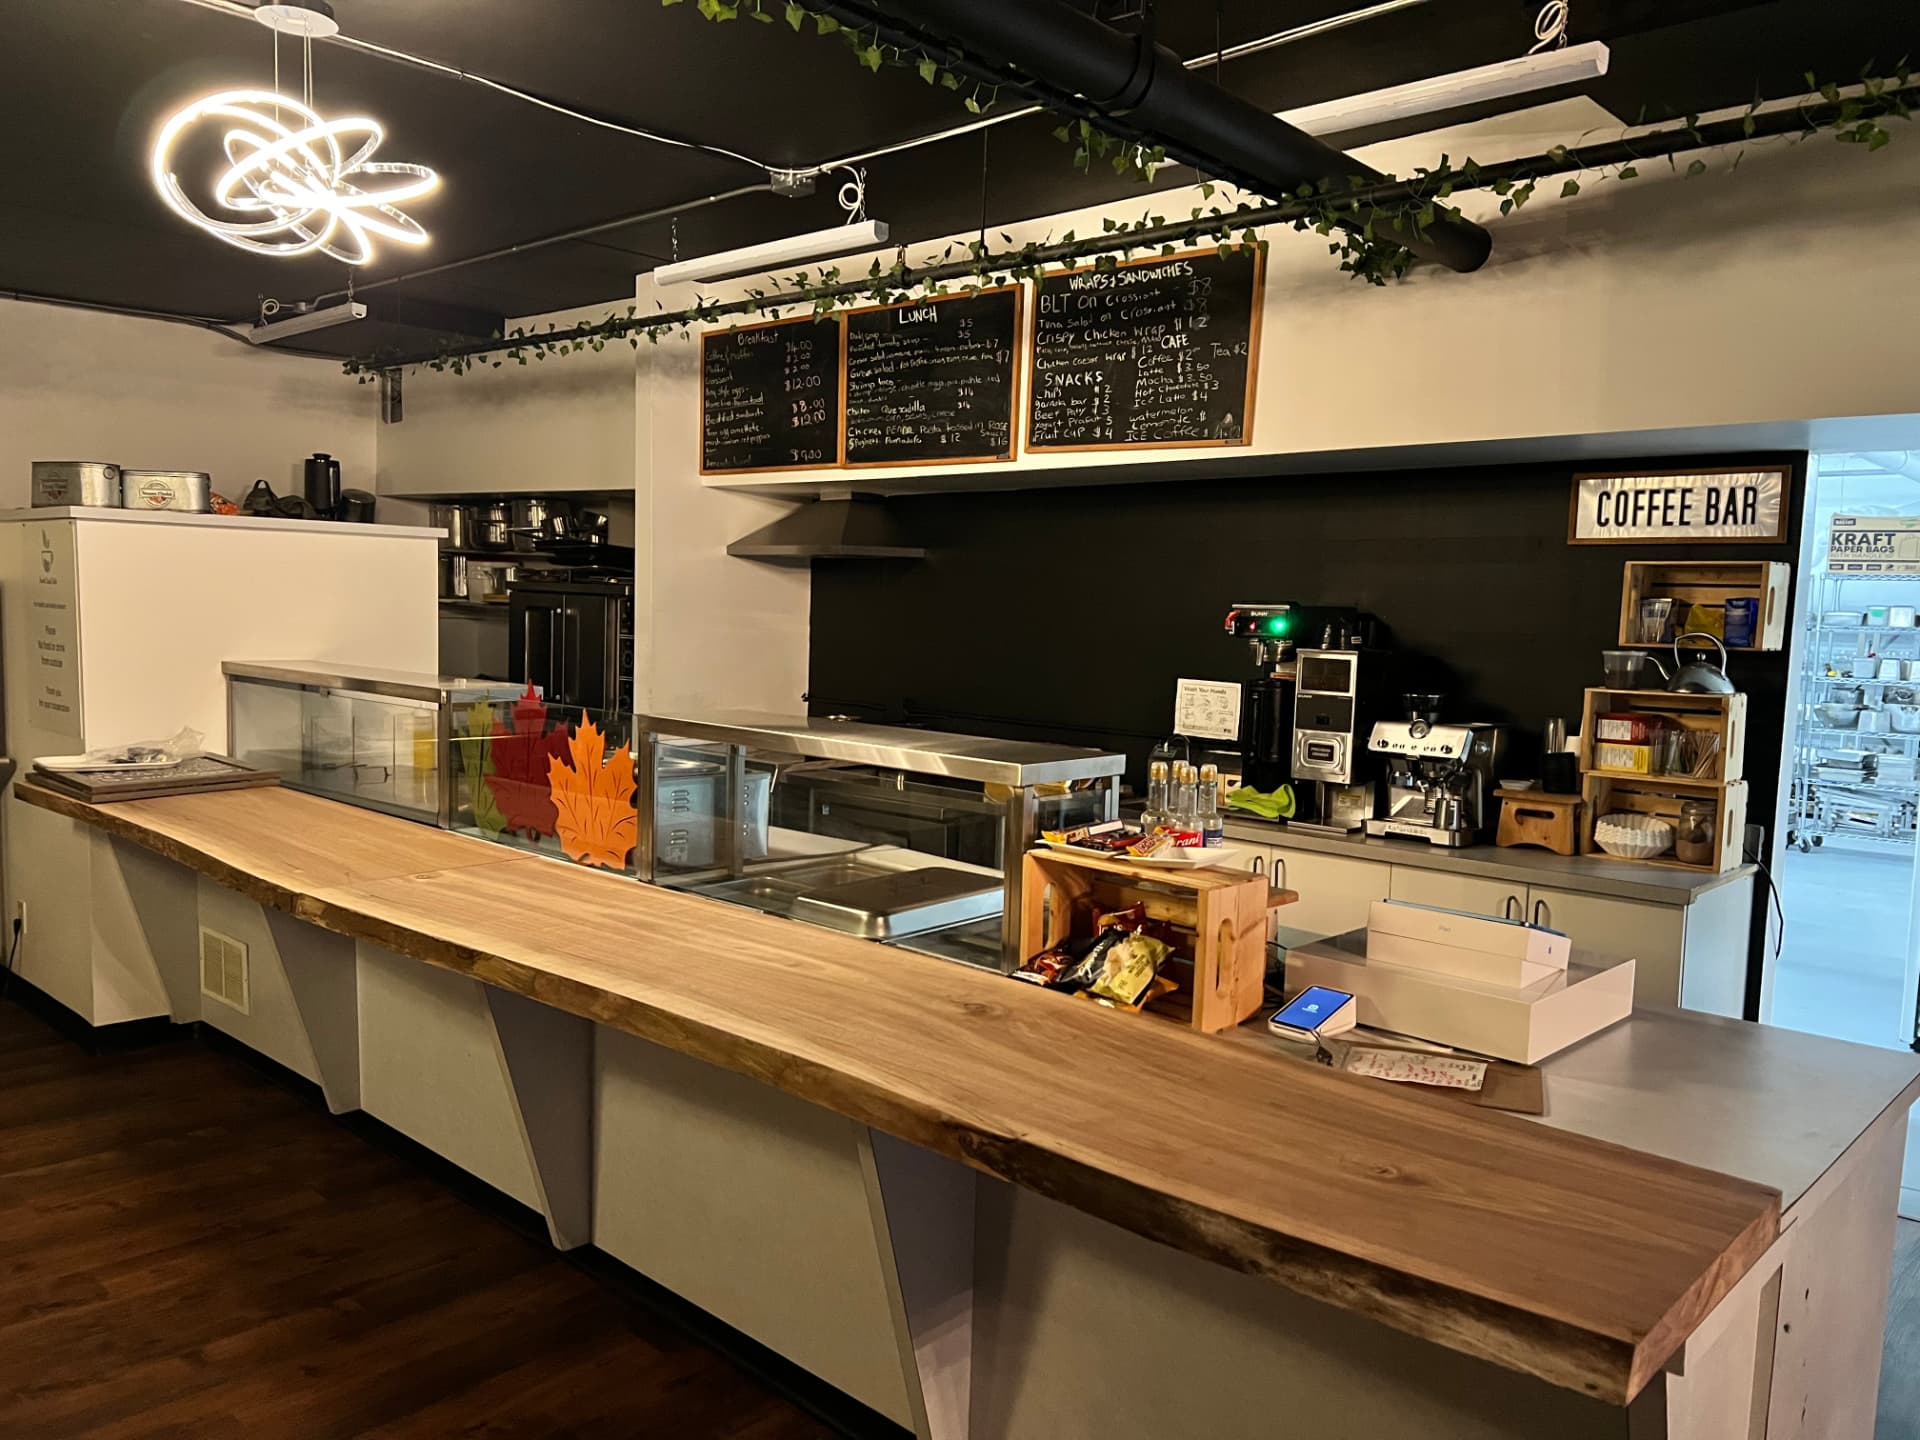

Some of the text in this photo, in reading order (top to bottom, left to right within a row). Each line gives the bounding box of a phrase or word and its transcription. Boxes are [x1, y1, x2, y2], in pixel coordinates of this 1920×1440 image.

[1117, 261, 1194, 287] SANDWICHES
[1041, 293, 1071, 314] BLT
[899, 305, 937, 324] LUNCH
[1038, 318, 1063, 329] Tuna
[1036, 331, 1075, 346] Crispy
[1084, 325, 1127, 341] Chicken
[1161, 334, 1190, 350] CAFE
[1210, 342, 1231, 359] Tea
[1138, 354, 1174, 369] Coffee
[1044, 371, 1104, 388] SNACKS
[1137, 374, 1174, 389] Mocha
[1135, 388, 1155, 399] Hot
[1033, 426, 1059, 441] Fruit
[1124, 430, 1149, 442] ICE
[1597, 486, 1757, 528] COFFEE BAR
[1831, 533, 1896, 545] KRAFT
